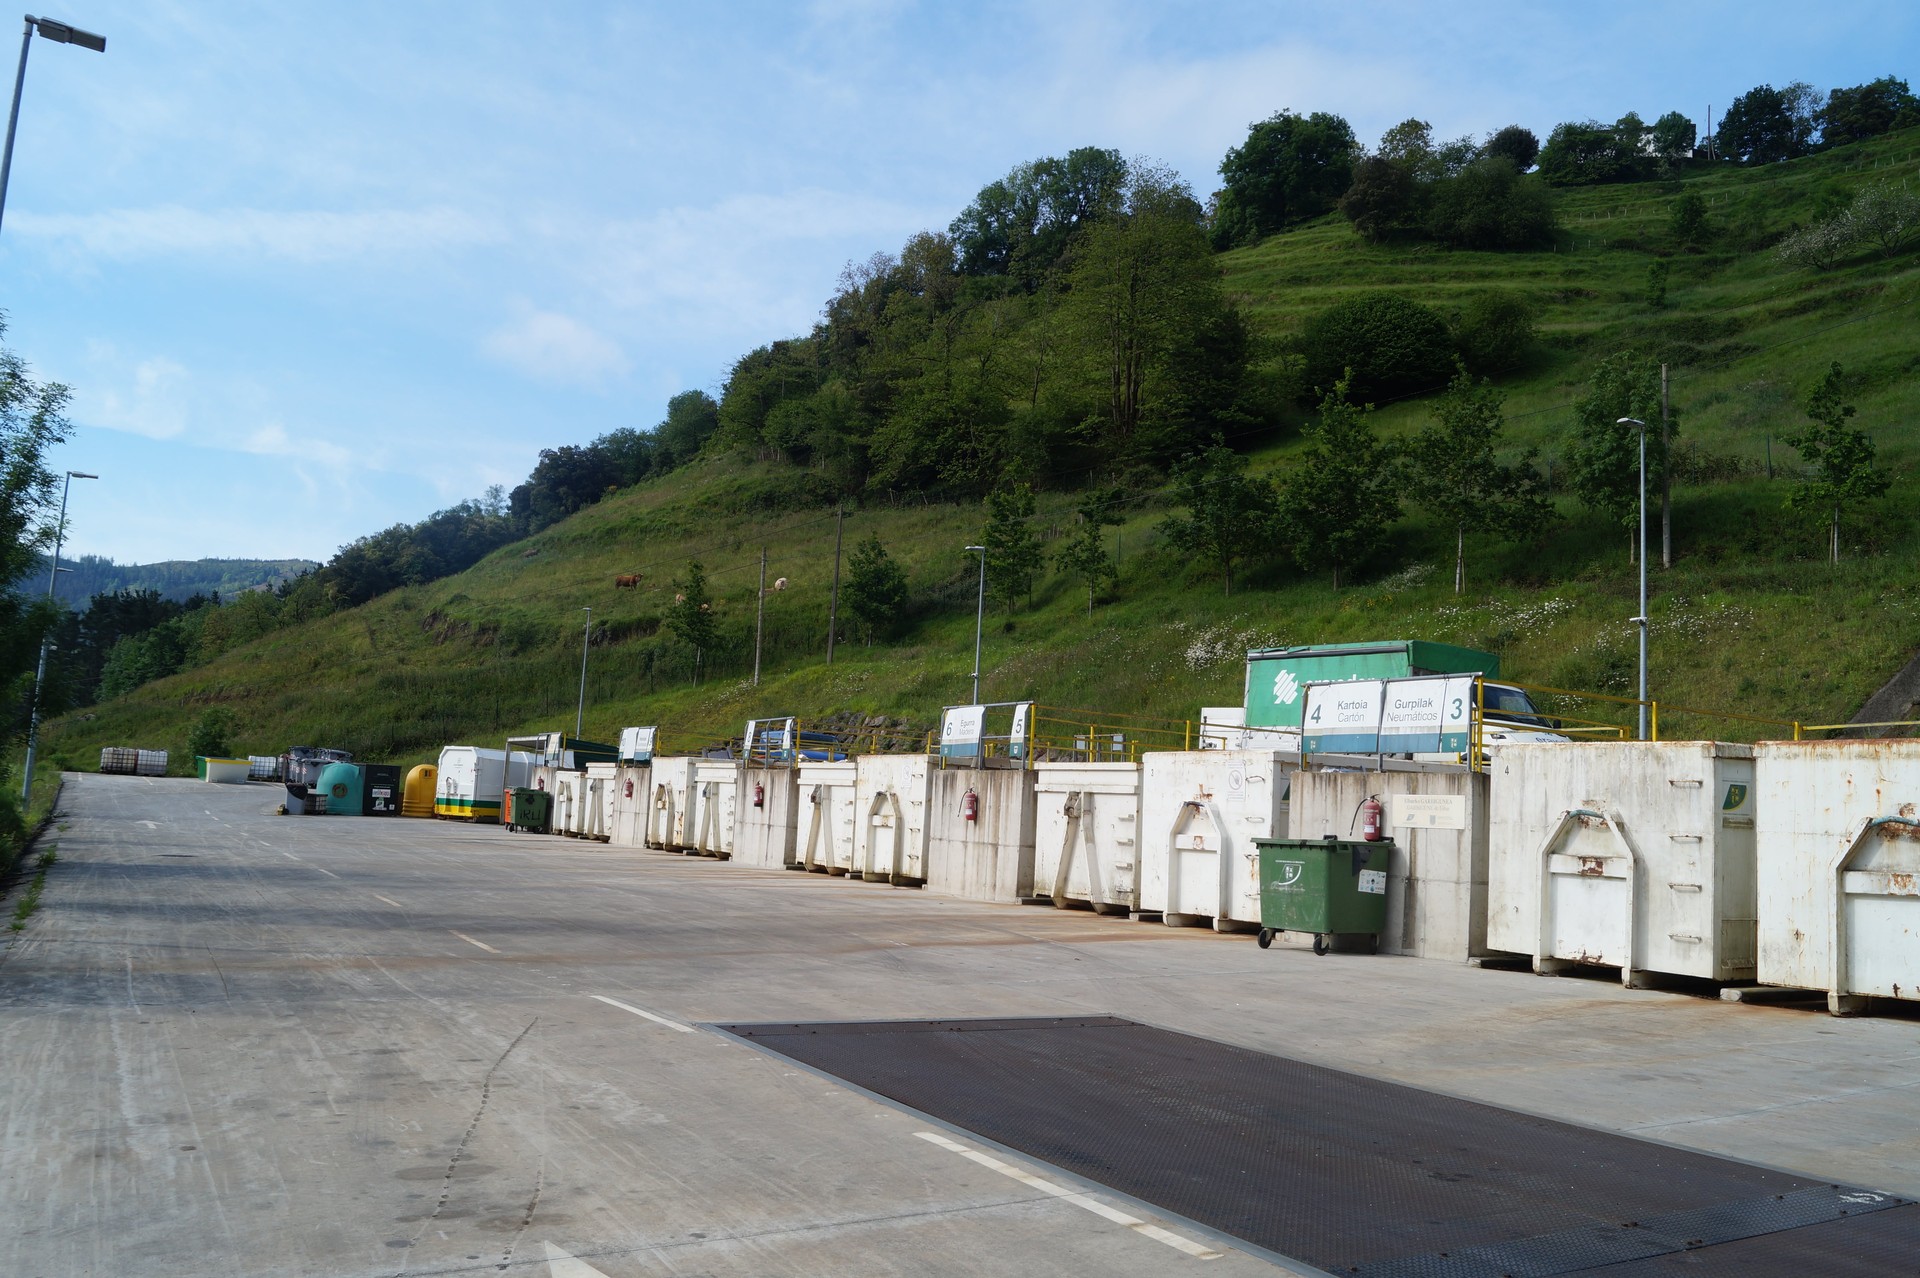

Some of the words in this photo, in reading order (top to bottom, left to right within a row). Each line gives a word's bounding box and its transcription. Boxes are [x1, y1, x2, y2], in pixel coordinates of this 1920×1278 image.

[1337, 700, 1368, 710] Kartoia
[1394, 698, 1433, 711] Gurpilak
[1450, 697, 1463, 720] 3
[1311, 703, 1321, 723] 4
[1337, 711, 1365, 722] Cartón
[1386, 711, 1438, 722] Neumáticos
[946, 722, 953, 736] 6
[1015, 719, 1022, 733] 5
[1504, 765, 1510, 775] 4
